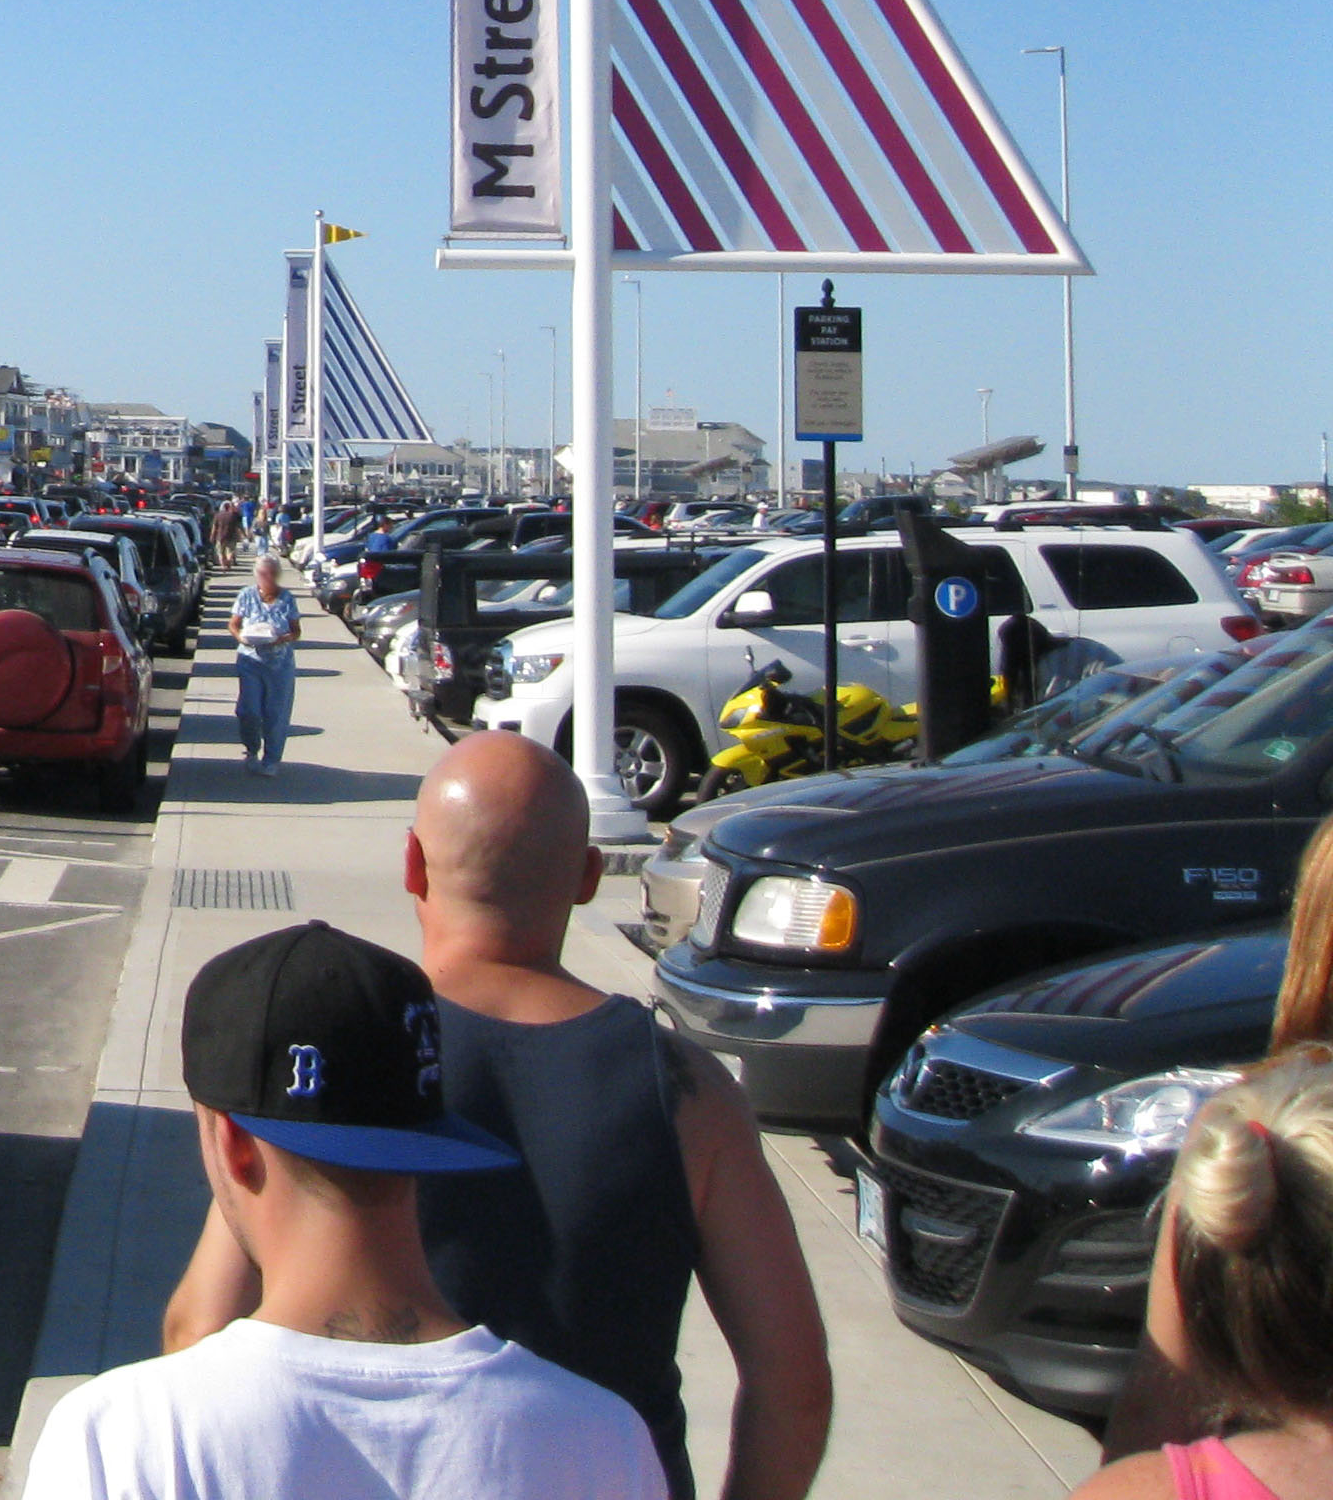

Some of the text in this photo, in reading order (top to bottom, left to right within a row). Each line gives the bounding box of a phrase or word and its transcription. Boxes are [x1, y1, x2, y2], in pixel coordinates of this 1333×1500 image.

[473, 144, 535, 199] M
[808, 314, 850, 323] PARKING
[821, 326, 838, 334] PAY
[811, 337, 849, 346] STATION
[291, 364, 307, 415] Street
[268, 408, 279, 440] Street
[948, 584, 966, 611] P
[286, 1044, 326, 1098] B
